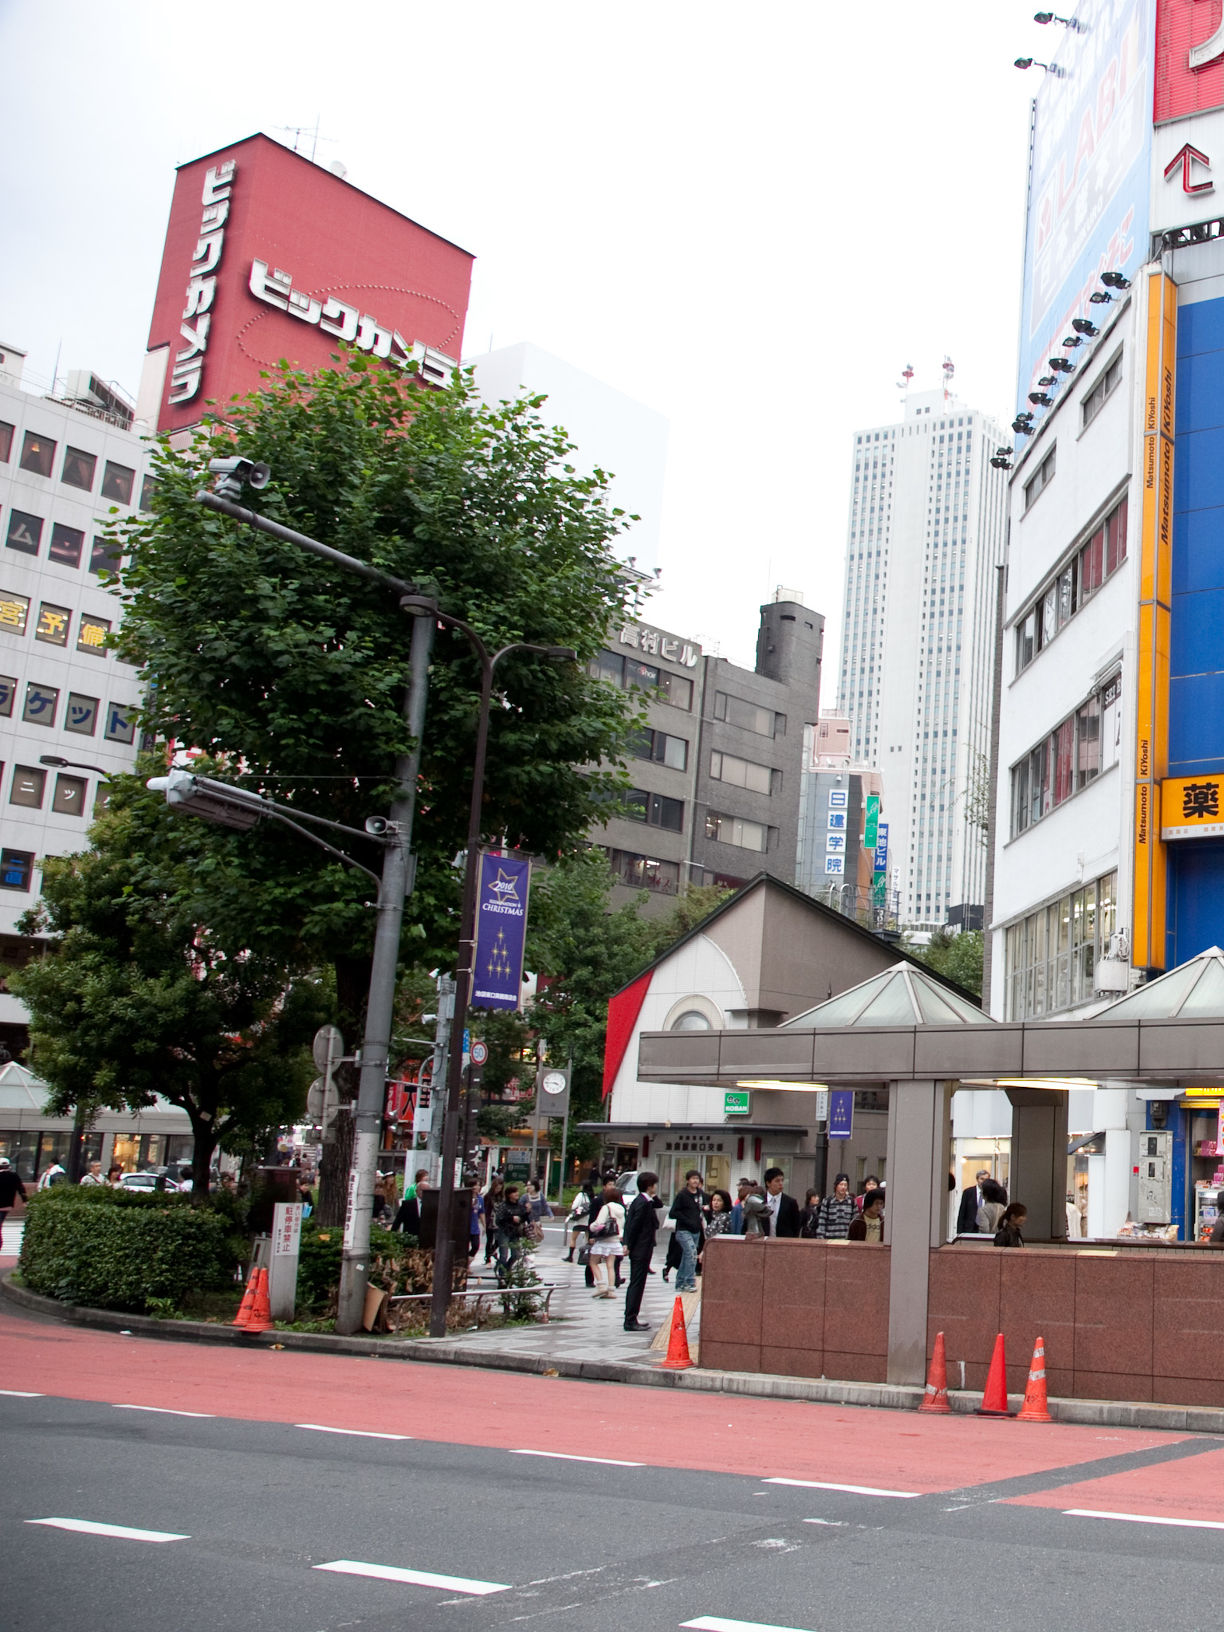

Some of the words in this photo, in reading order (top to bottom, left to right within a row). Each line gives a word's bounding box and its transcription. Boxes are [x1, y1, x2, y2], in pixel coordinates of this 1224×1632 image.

[168, 158, 237, 405] ビックカメラ
[248, 257, 458, 390] ビックカメラ
[1146, 436, 1155, 489] Matsumoto
[1160, 440, 1171, 546] Matsumoto
[826, 792, 846, 873] 日建学院
[1138, 786, 1148, 844] Matsumoto
[1182, 783, 1220, 819] 薬
[482, 903, 524, 916] CHRISTMAS
